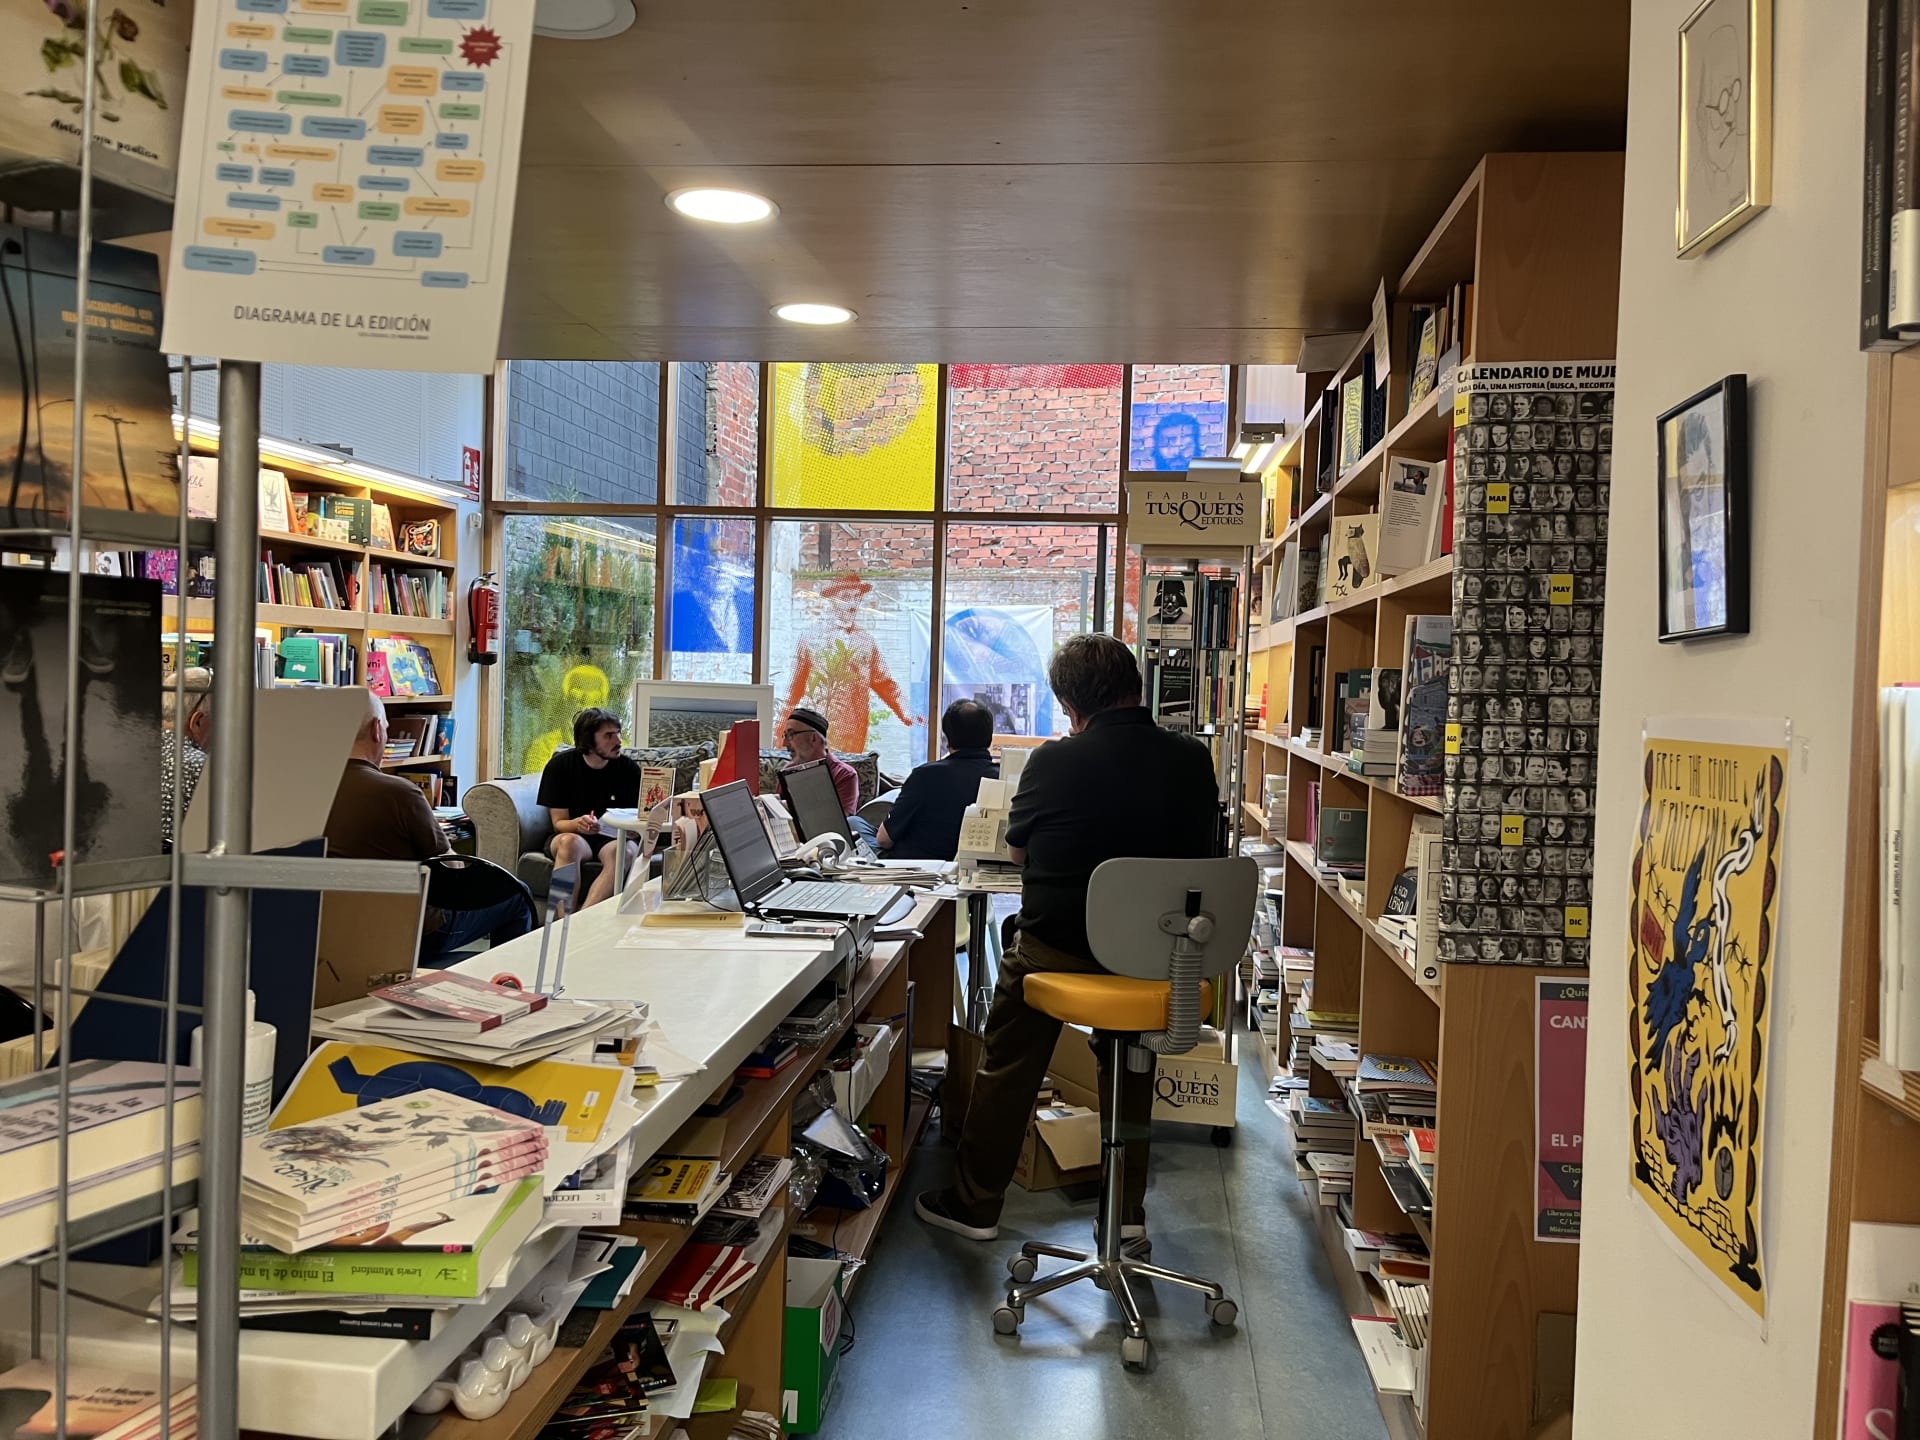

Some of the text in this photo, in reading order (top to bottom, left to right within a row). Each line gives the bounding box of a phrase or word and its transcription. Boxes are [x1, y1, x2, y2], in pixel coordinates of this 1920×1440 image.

[233, 304, 431, 332] DIAGRAMA DE LA EDICIÓN
[1457, 366, 1549, 384] CALENDARIO
[1552, 366, 1573, 379] DE
[1508, 382, 1546, 390] HISTORIA
[1455, 408, 1466, 416] ENE
[1147, 491, 1244, 500] FABULA
[1488, 494, 1507, 503] MAR
[1145, 499, 1244, 531] TUSQUETS
[1201, 516, 1244, 525] EDITORES
[1552, 585, 1570, 593] MAY
[1446, 735, 1457, 744] AGO
[1655, 752, 1681, 790] FREE
[1708, 757, 1738, 803] PEOPLE
[1504, 826, 1519, 834] OCT
[1569, 918, 1583, 926] DIC
[1155, 1076, 1219, 1108] QUETS
[1177, 1094, 1219, 1106] EDITORES
[1551, 1133, 1568, 1147] EL
[1572, 1179, 1579, 1188] y
[258, 1267, 270, 1280] la
[273, 1268, 288, 1281] de
[291, 1269, 319, 1281] mito
[322, 1270, 334, 1282] El
[351, 1265, 422, 1277] Lewis Mumford
